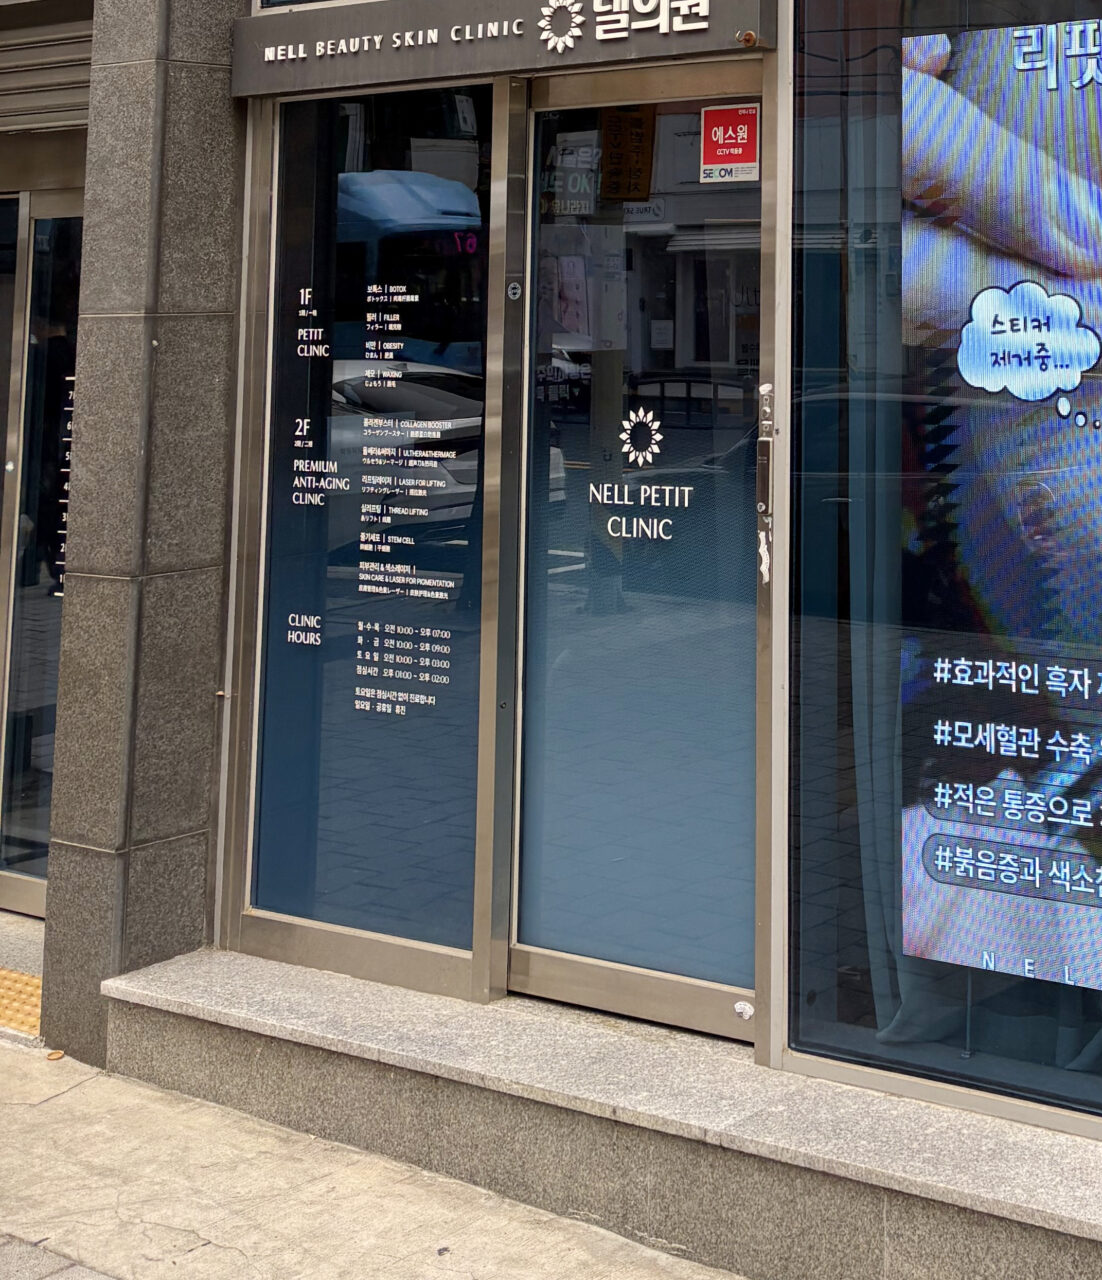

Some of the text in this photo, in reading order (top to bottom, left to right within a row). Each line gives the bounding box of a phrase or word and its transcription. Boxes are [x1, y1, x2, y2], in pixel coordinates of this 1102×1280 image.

[264, 19, 524, 62] NELL BEAUTY SKIN CLINIC
[712, 124, 748, 144] 에스원
[703, 168, 733, 178] SECOM
[299, 288, 313, 305] 1F
[991, 314, 1052, 335] 스티커
[297, 328, 324, 341] PETIT
[297, 344, 330, 357] CLINIC
[294, 418, 311, 436] 2F
[400, 420, 427, 428] COLLAGEN
[428, 421, 452, 429] BOOSTER
[293, 459, 338, 474] PREMIUM
[293, 476, 350, 490] ANTI-AGING
[399, 478, 415, 486] LASER
[426, 480, 446, 488] LIFTING
[292, 493, 325, 506] CLINIC
[589, 483, 694, 508] NELL PETIT
[388, 507, 409, 515] THREAD
[409, 508, 429, 516] LIFTING
[607, 516, 673, 540] CLINIC
[387, 535, 402, 544] STEM
[402, 537, 415, 545] CELL
[359, 573, 371, 581] SKIN
[389, 576, 405, 584] LASER
[406, 577, 417, 585] FOR
[288, 613, 322, 628] CLINIC
[288, 631, 321, 645] HOURS
[432, 629, 451, 639] 07:00
[431, 644, 451, 654] 09:00
[933, 657, 1040, 696] #효과적인
[1046, 666, 1092, 701] 흑자
[933, 718, 1041, 759] #모세혈관
[1046, 731, 1093, 766] 수축
[934, 781, 997, 817] #적은
[1002, 790, 1093, 828] 통증으로
[934, 842, 1043, 890] #붉음증과
